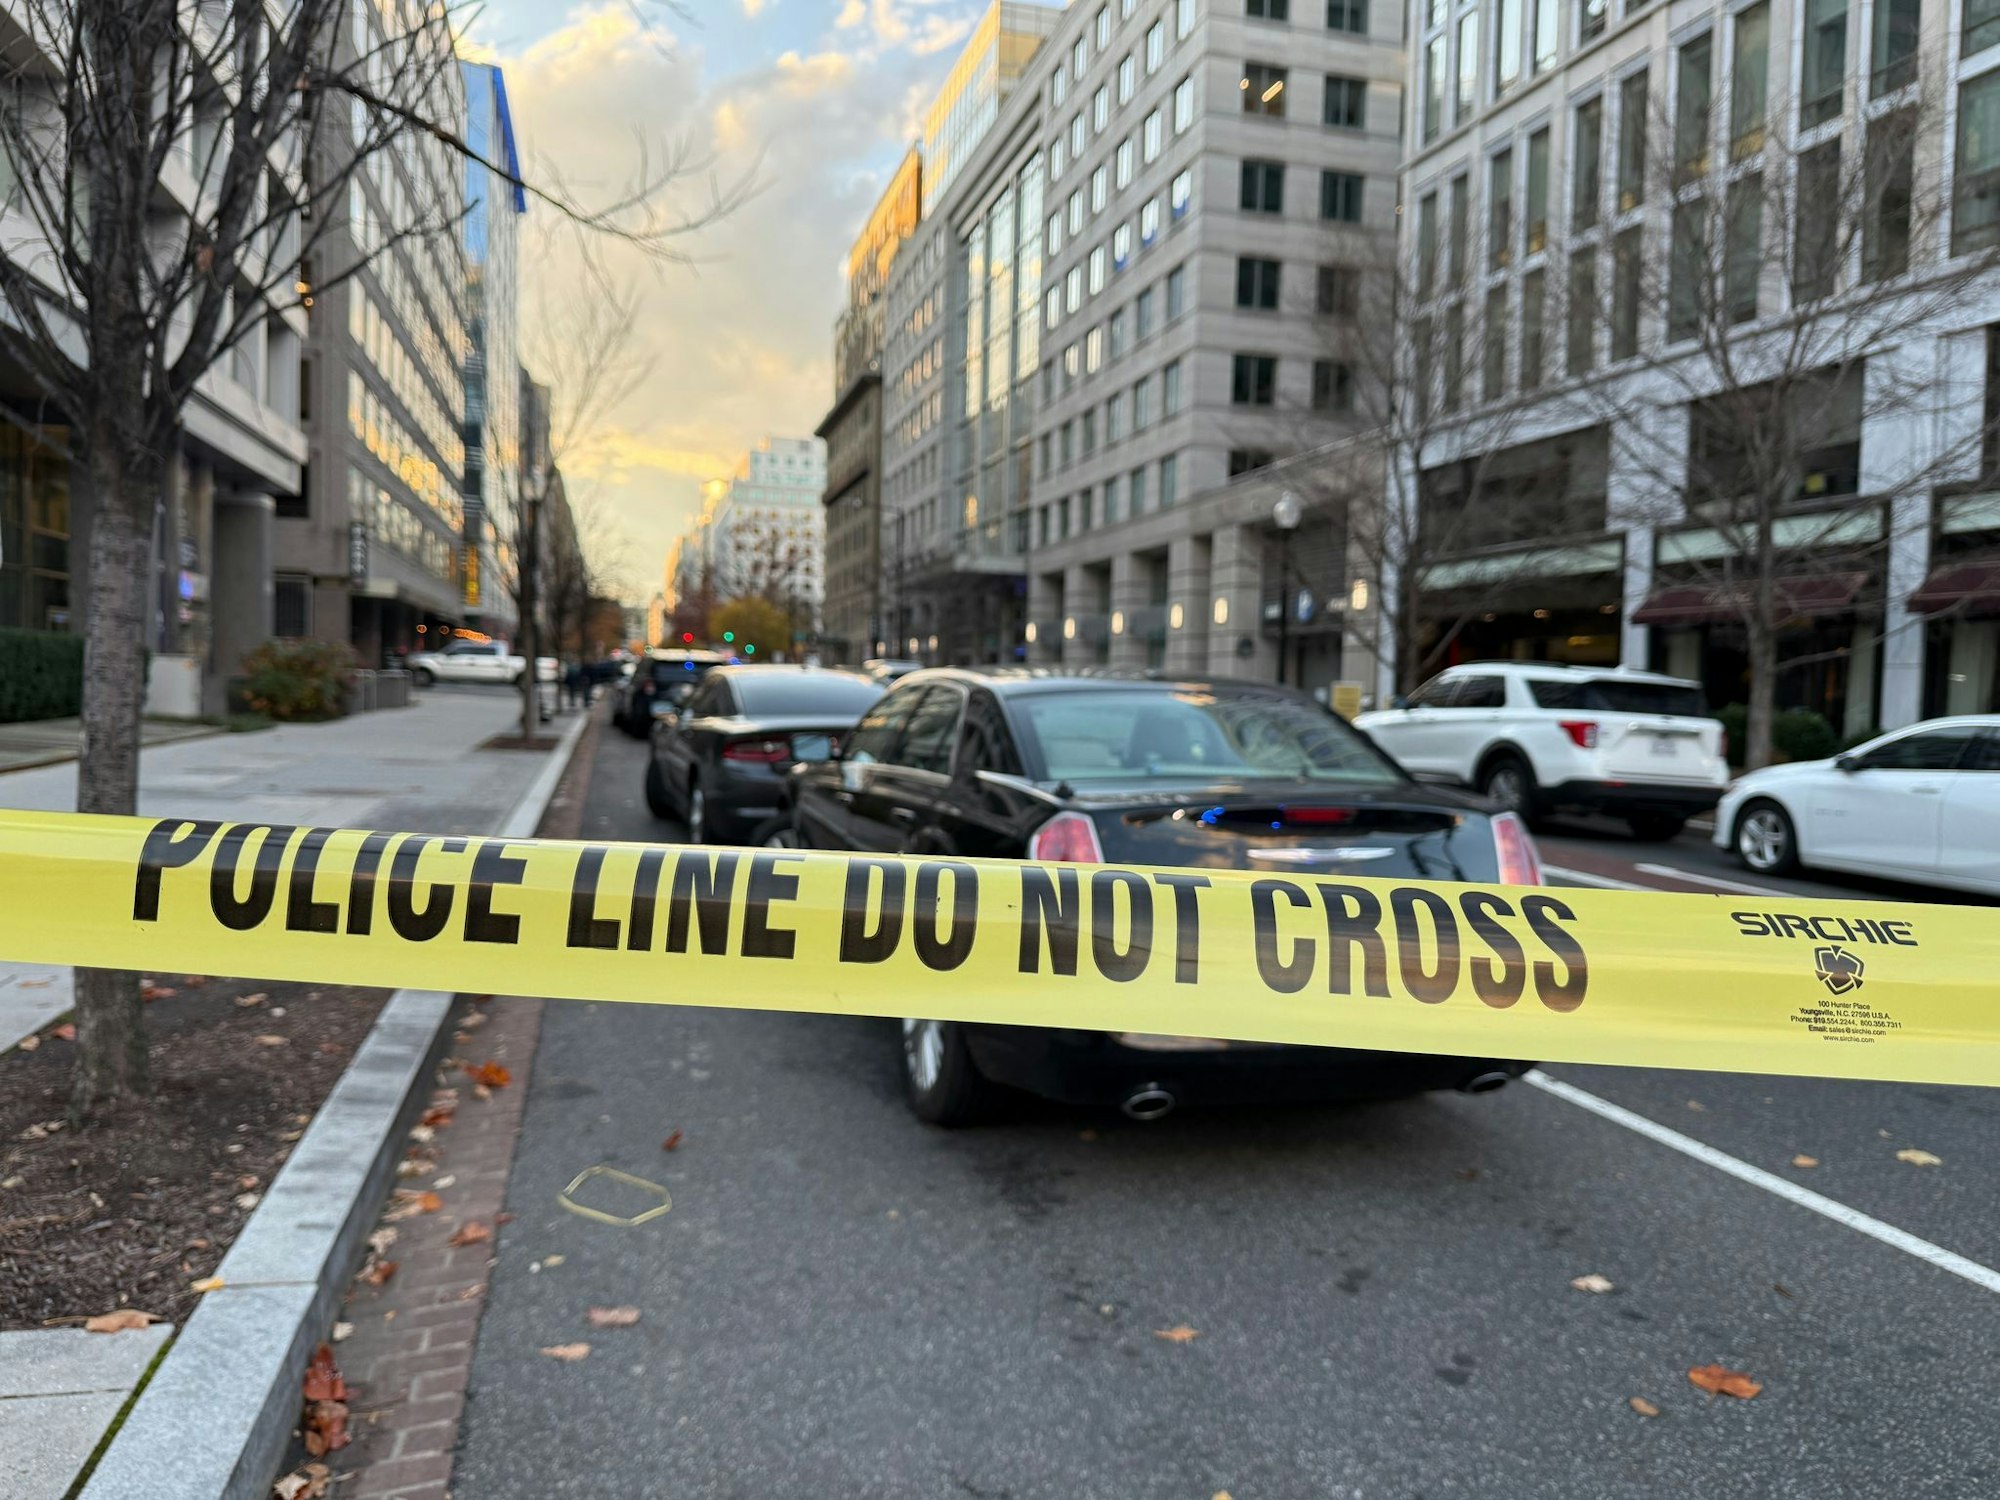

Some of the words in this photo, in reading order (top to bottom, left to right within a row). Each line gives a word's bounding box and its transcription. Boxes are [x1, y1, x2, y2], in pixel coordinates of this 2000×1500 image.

[132, 818, 531, 944] POLICE
[567, 845, 804, 959] LINE
[839, 856, 979, 972] DO
[1017, 864, 1212, 984] NOT
[1249, 879, 1588, 1013] CROSS
[1790, 1015, 1812, 1023] Phone:
[1808, 1024, 1828, 1032] Email:
[1823, 1035, 1875, 1043] www.sirchie.com
